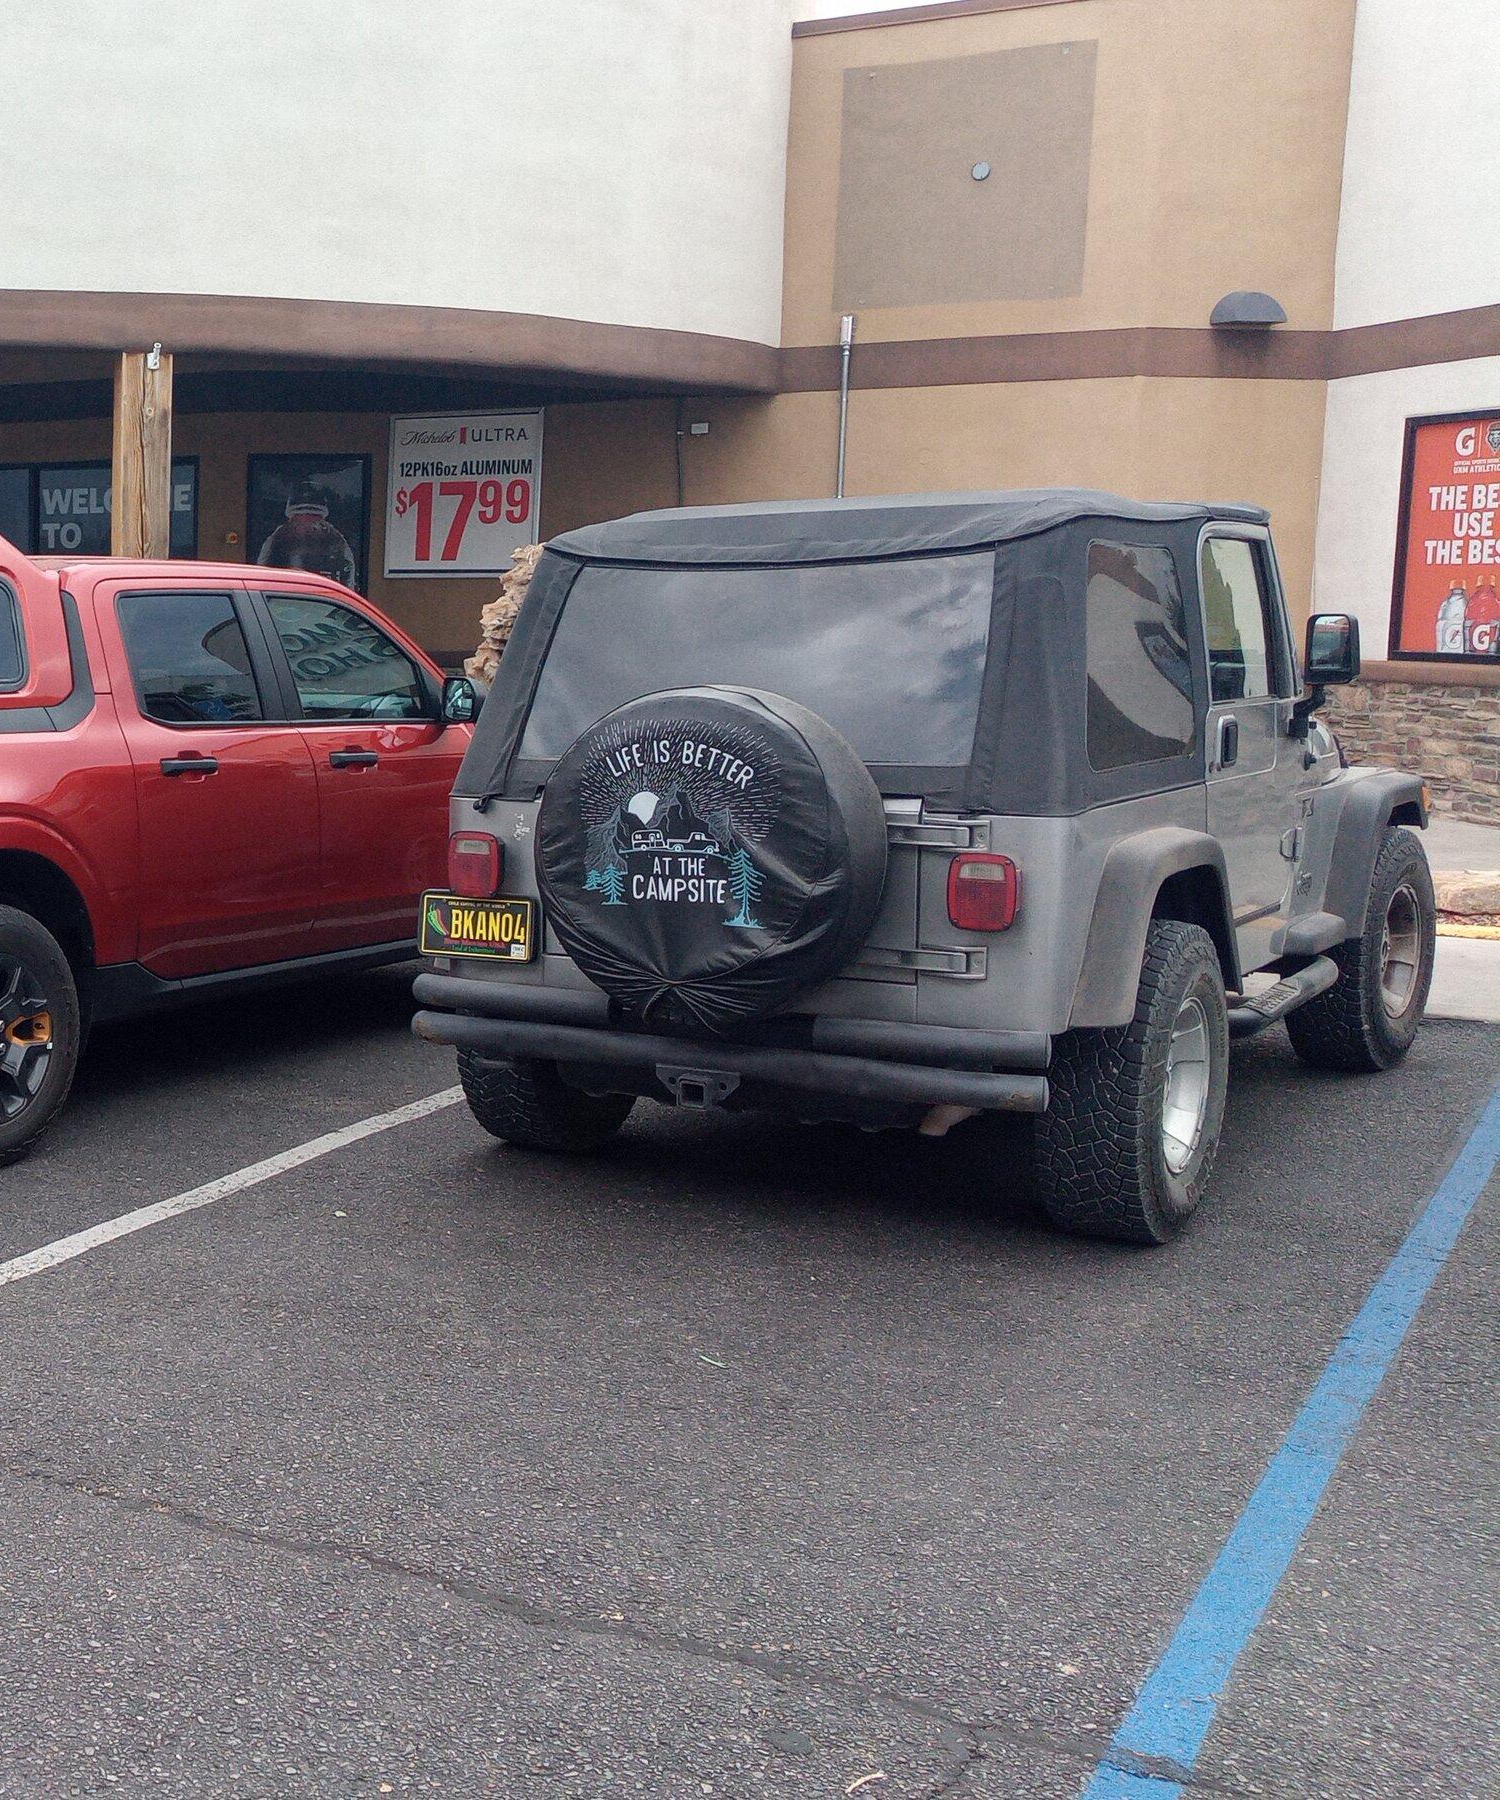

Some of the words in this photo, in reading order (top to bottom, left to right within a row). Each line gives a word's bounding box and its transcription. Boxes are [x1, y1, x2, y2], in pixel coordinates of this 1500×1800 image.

[471, 428, 529, 442] ULTRA
[1455, 427, 1476, 456] G
[460, 460, 532, 475] ALUMINUM
[1429, 485, 1468, 511] THE
[41, 522, 82, 549] TO
[1453, 512, 1494, 537] USE
[1424, 540, 1463, 565] THE
[1472, 624, 1490, 650] G
[606, 743, 645, 777] LIFE
[654, 740, 670, 763] IS
[683, 740, 754, 790] BETTER
[652, 857, 676, 876] AT
[678, 858, 706, 876] THE
[632, 876, 728, 903] CAMPSITE
